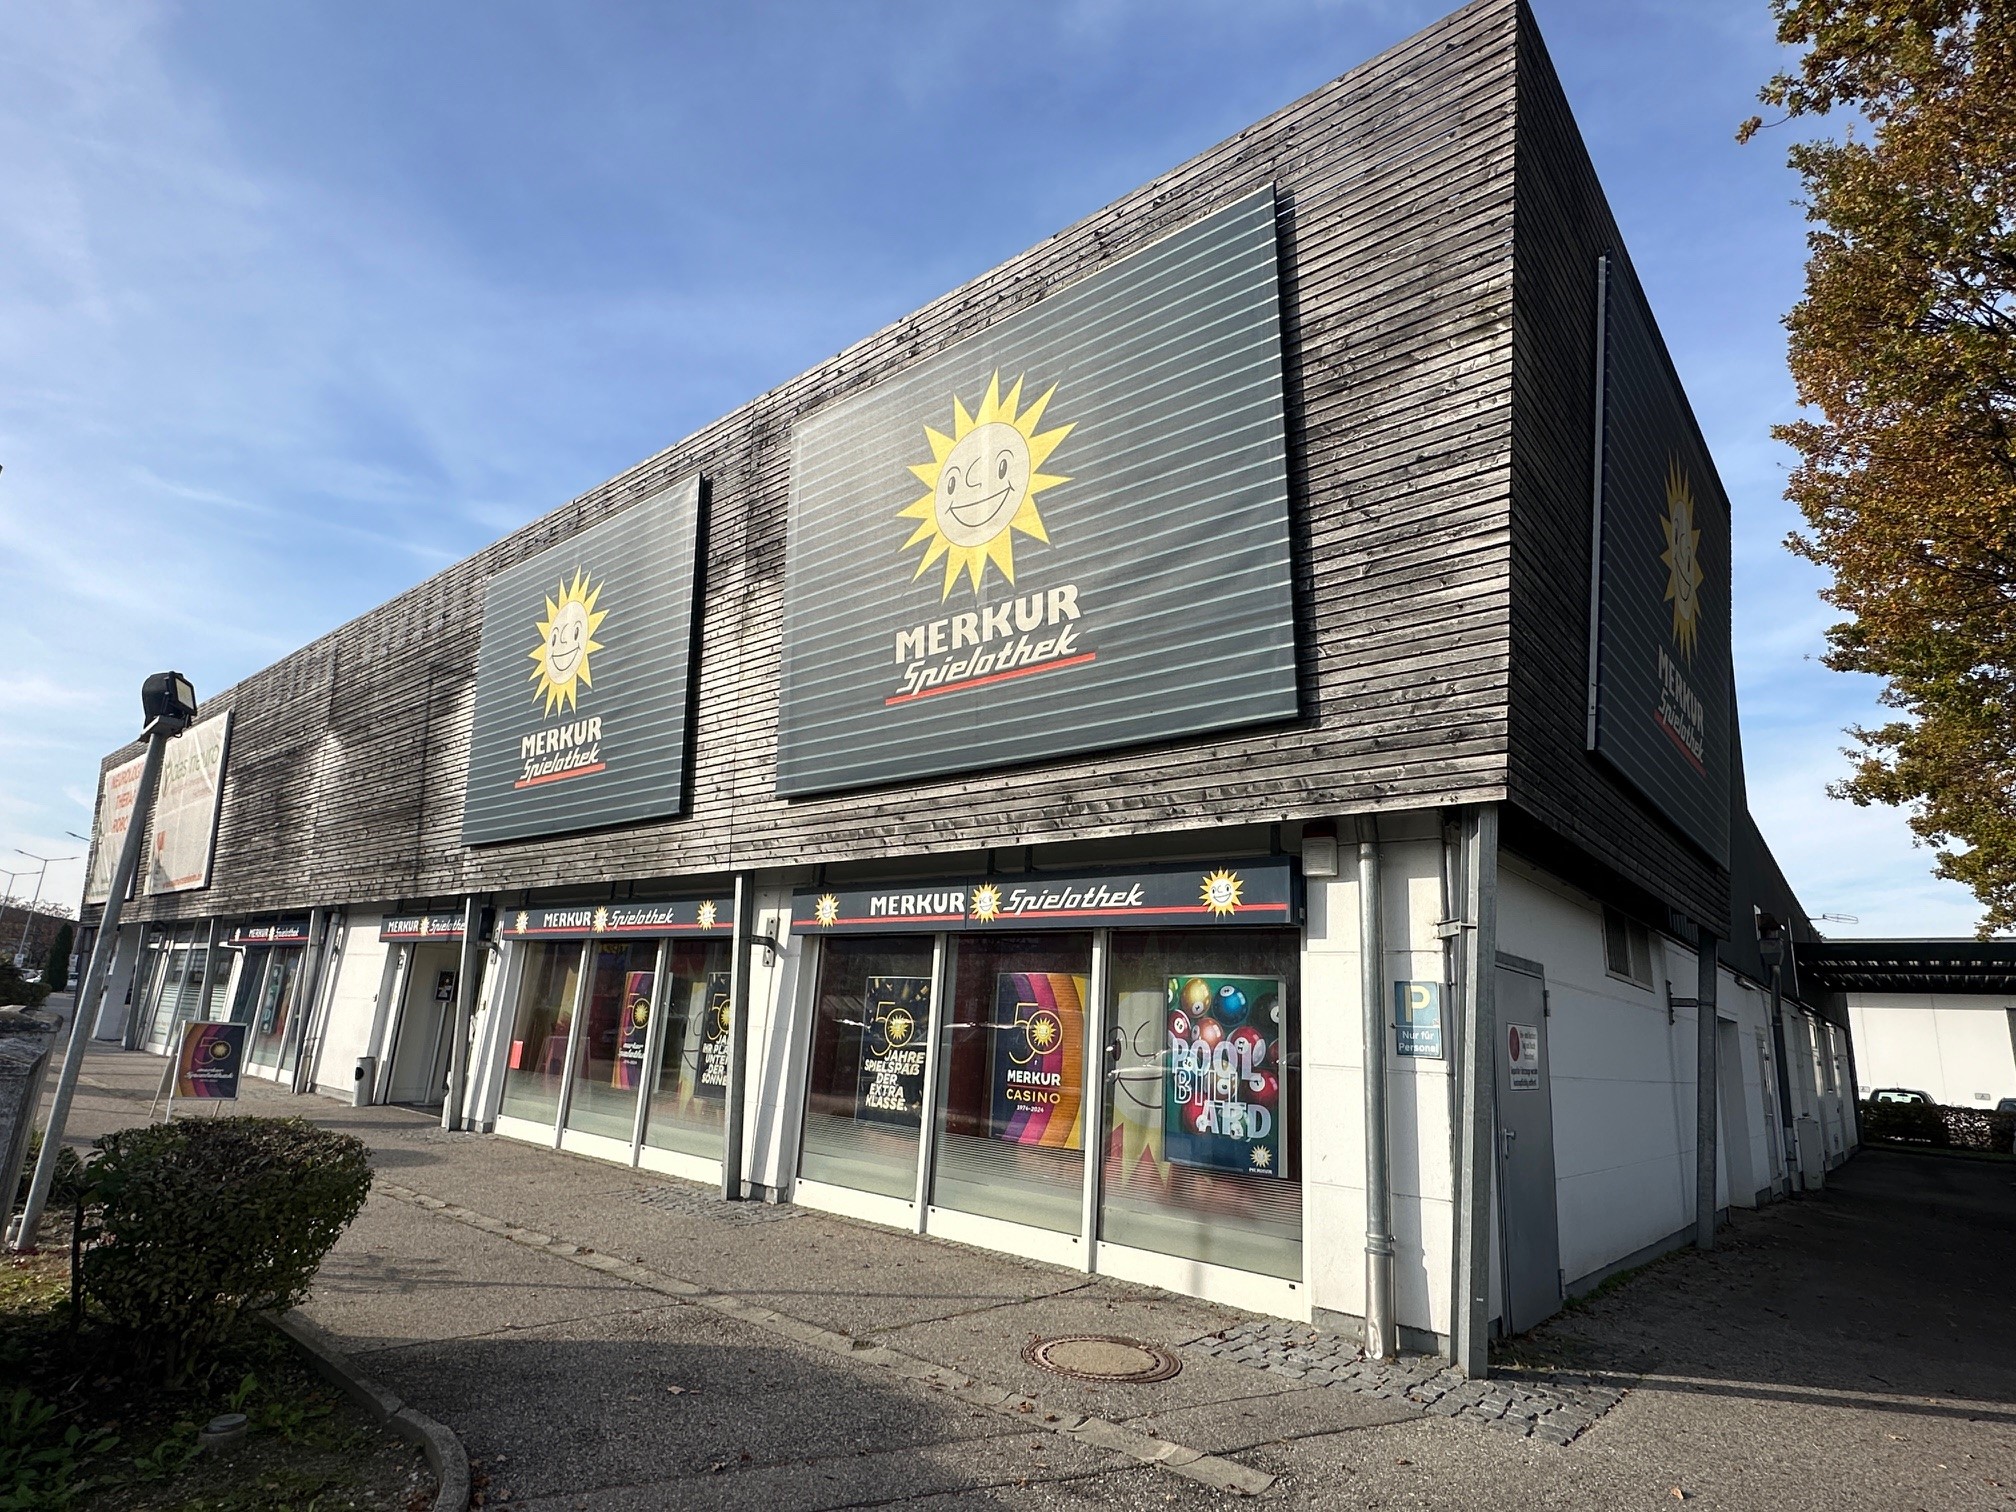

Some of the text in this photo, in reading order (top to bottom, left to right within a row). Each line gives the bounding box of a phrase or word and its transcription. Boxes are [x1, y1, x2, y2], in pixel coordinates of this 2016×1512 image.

[895, 584, 1082, 664] MERKUR
[896, 623, 1081, 695] Spielothek
[1658, 644, 1704, 737] MERKUR
[1657, 687, 1704, 763] Spielothek
[521, 717, 602, 759] MERKUR
[519, 742, 601, 783] Spielothek
[869, 882, 1146, 916] MERKUR Spielothek
[387, 918, 466, 935] MERKUR Spielothe
[543, 907, 675, 930] MERKUR Spielothek
[248, 928, 269, 938] MERKUR
[1404, 985, 1431, 1023] P
[1402, 1030, 1435, 1040] Nur für
[713, 1044, 729, 1055] PLA
[884, 1049, 926, 1064] JAHRE
[1398, 1042, 1440, 1054] Personal
[1172, 1038, 1262, 1081] POOL
[707, 1064, 725, 1075] DER
[1007, 1069, 1061, 1086] MERKUR
[875, 1073, 898, 1086] DER
[869, 1083, 905, 1098] EXTRA
[1006, 1088, 1061, 1104] CASINO
[865, 1094, 908, 1112] KLASSE.
[1198, 1100, 1272, 1139] ARD
